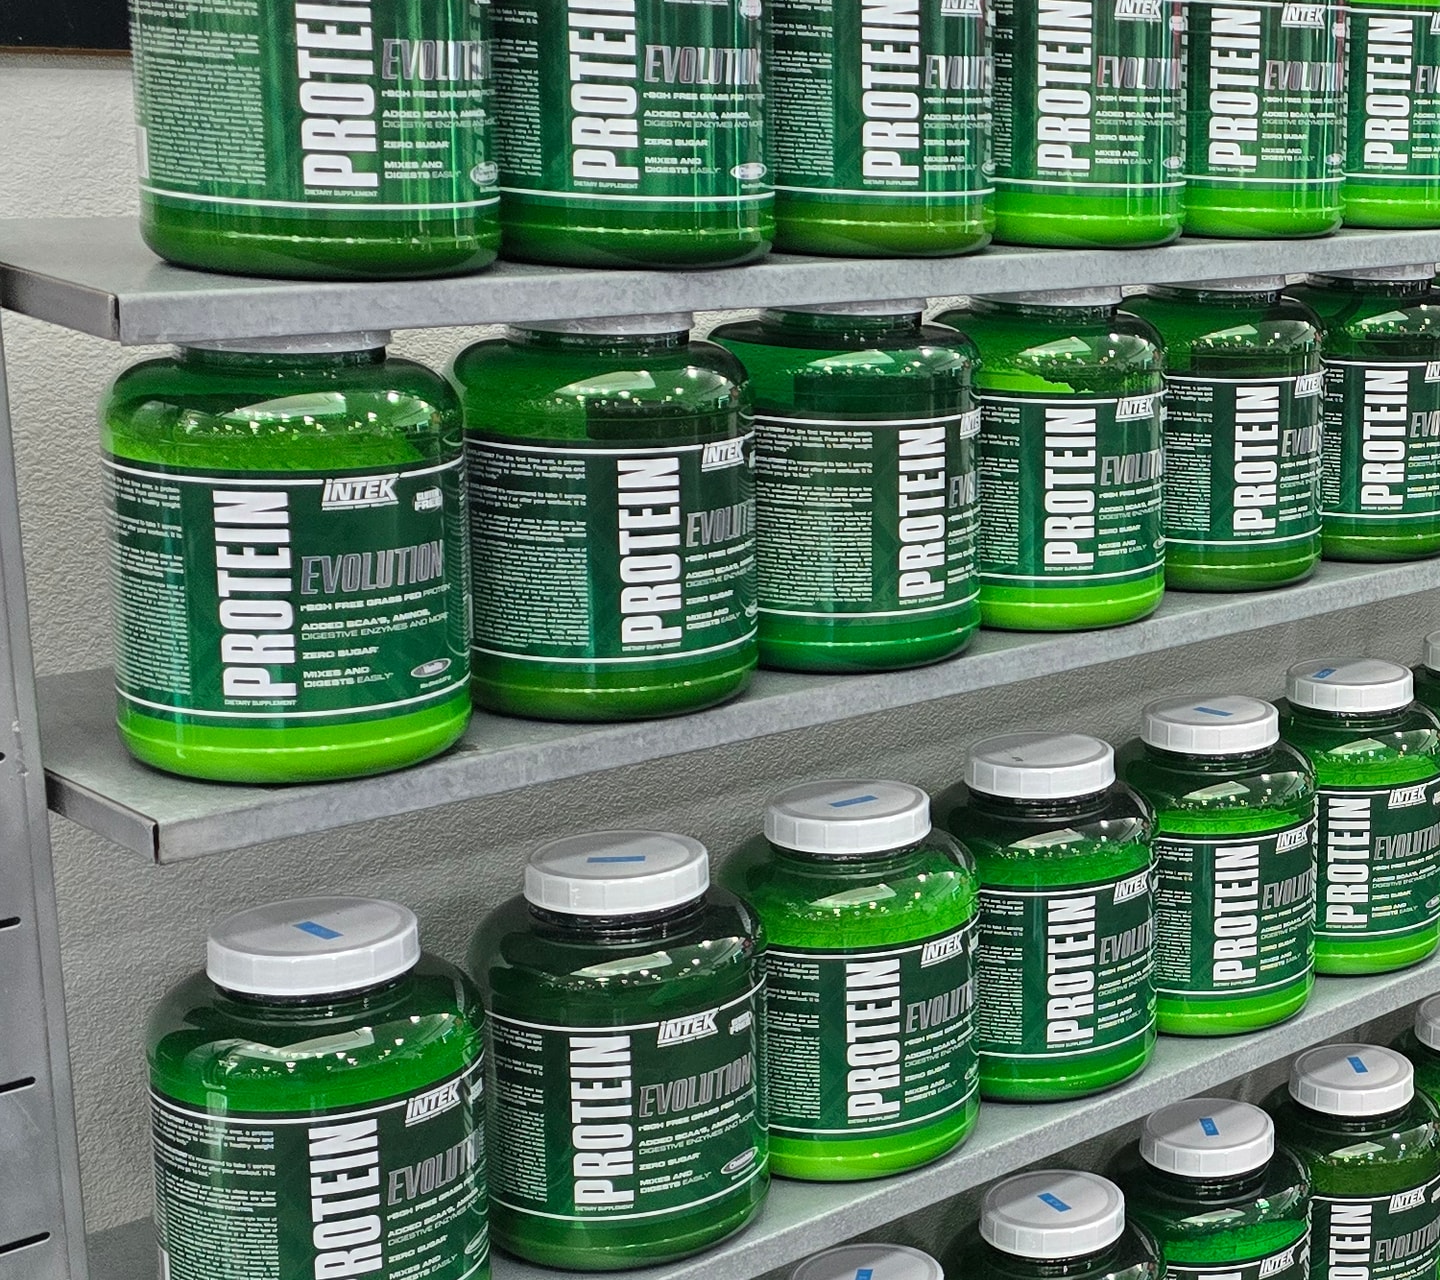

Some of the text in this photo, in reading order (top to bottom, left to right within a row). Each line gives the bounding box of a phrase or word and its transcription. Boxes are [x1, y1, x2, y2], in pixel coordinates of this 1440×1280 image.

[1281, 3, 1325, 29] INTEK
[1038, 0, 1092, 172] PROTEIN
[1208, 8, 1261, 166] PROTEIN
[1364, 18, 1413, 166] PROTEIN
[1115, 398, 1155, 421] INTEK
[1360, 370, 1409, 506] PROTEIN
[702, 440, 744, 468] INTEK
[1044, 408, 1096, 565] PROTEIN
[1233, 386, 1279, 531] PROTEIN
[322, 473, 398, 506] INTEK
[898, 427, 945, 598] PROTEIN
[301, 540, 443, 595] EVOLUTION
[617, 457, 682, 644] PROTEIN
[213, 490, 297, 697] PROTEIN
[303, 666, 370, 678] MIXES AND
[1388, 785, 1427, 808] INTEK
[1276, 830, 1308, 853] INTEK
[1326, 799, 1370, 925] PROTEIN
[1113, 873, 1148, 904] INTEK
[1213, 845, 1259, 982] PROTEIN
[921, 934, 964, 967] INTEK
[1047, 896, 1096, 1043] PROTEIN
[657, 1008, 719, 1044] INTEK
[846, 958, 900, 1118] PROTEIN
[405, 1078, 462, 1122] INTEK
[639, 1052, 751, 1118] EVOLUTION
[569, 1035, 634, 1204] PROTEIN
[1389, 1187, 1427, 1213] INTEK
[1258, 1250, 1295, 1280] INTEK
